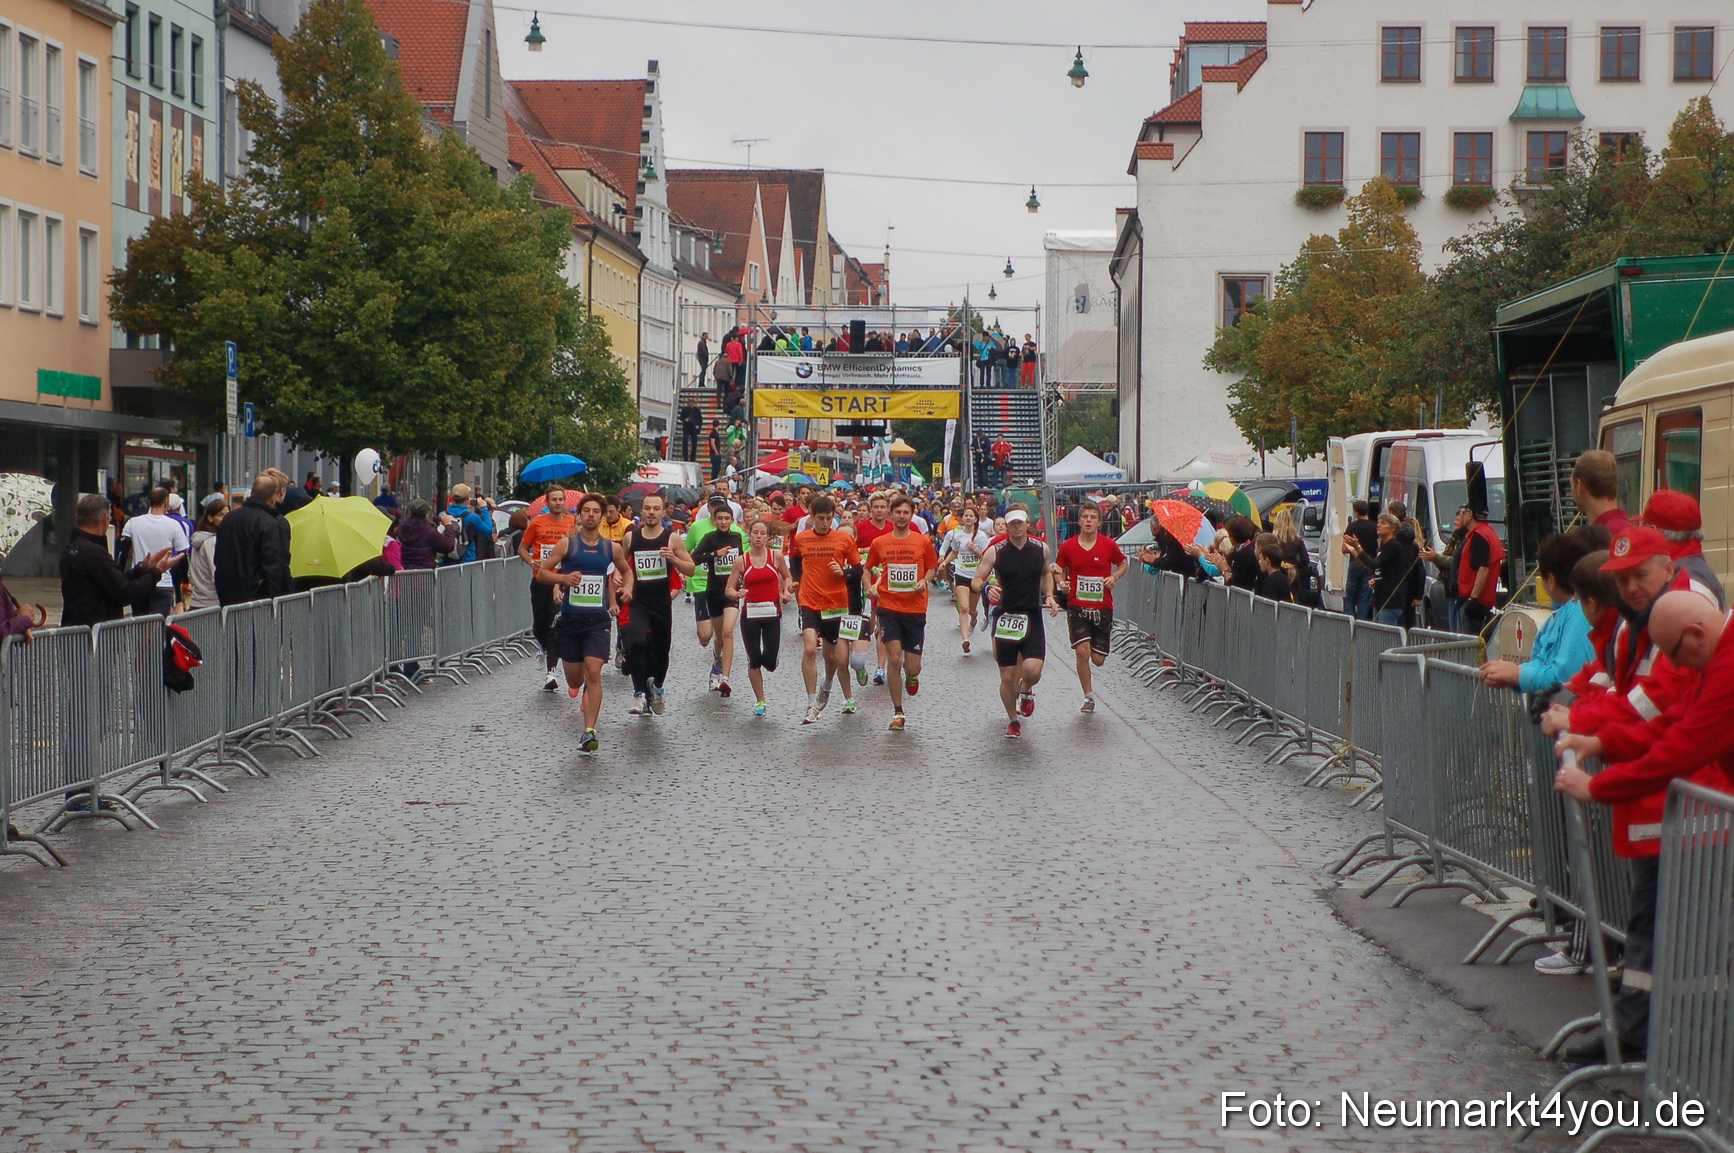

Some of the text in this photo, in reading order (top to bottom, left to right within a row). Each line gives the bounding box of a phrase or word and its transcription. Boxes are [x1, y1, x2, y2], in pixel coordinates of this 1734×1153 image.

[817, 363, 841, 371] BMW
[820, 396, 891, 413] START
[246, 408, 252, 433] P
[820, 472, 826, 481] A
[638, 557, 662, 569] 5071
[890, 570, 914, 581] 5086
[574, 584, 600, 594] 5182
[1080, 582, 1101, 592] 5153
[1000, 616, 1024, 631] 5186
